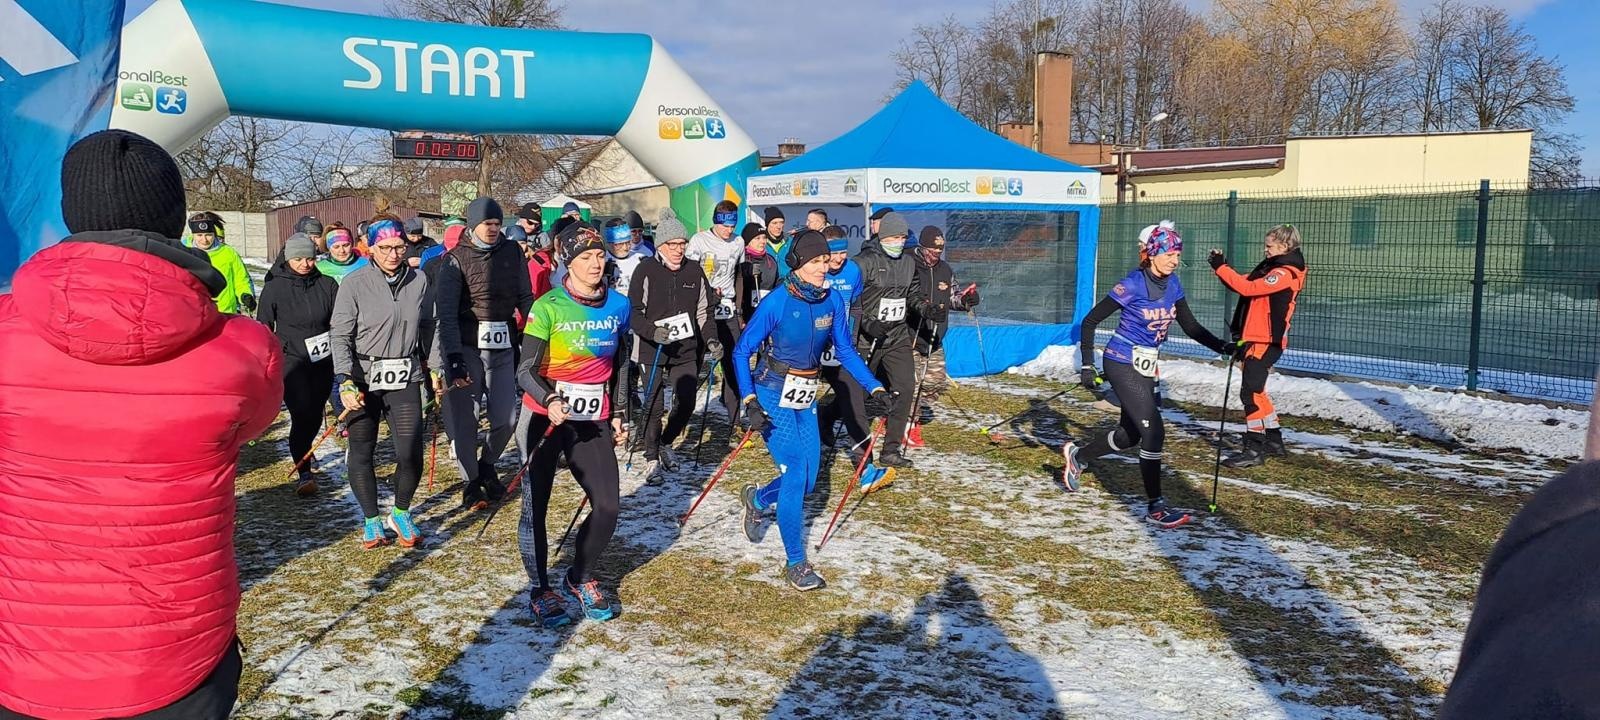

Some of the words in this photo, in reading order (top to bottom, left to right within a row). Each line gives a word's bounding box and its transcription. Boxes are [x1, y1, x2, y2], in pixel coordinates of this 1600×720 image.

[343, 37, 535, 99] START
[119, 70, 188, 87] onalBest
[883, 178, 971, 194] PersonalBest
[716, 306, 731, 315] 29
[880, 306, 904, 317] 417
[671, 322, 689, 336] 31
[481, 331, 507, 344] 407
[311, 341, 329, 356] 42
[1134, 356, 1156, 371] 401
[372, 370, 409, 384] 402
[784, 388, 815, 404] 425
[572, 397, 600, 414] 09
